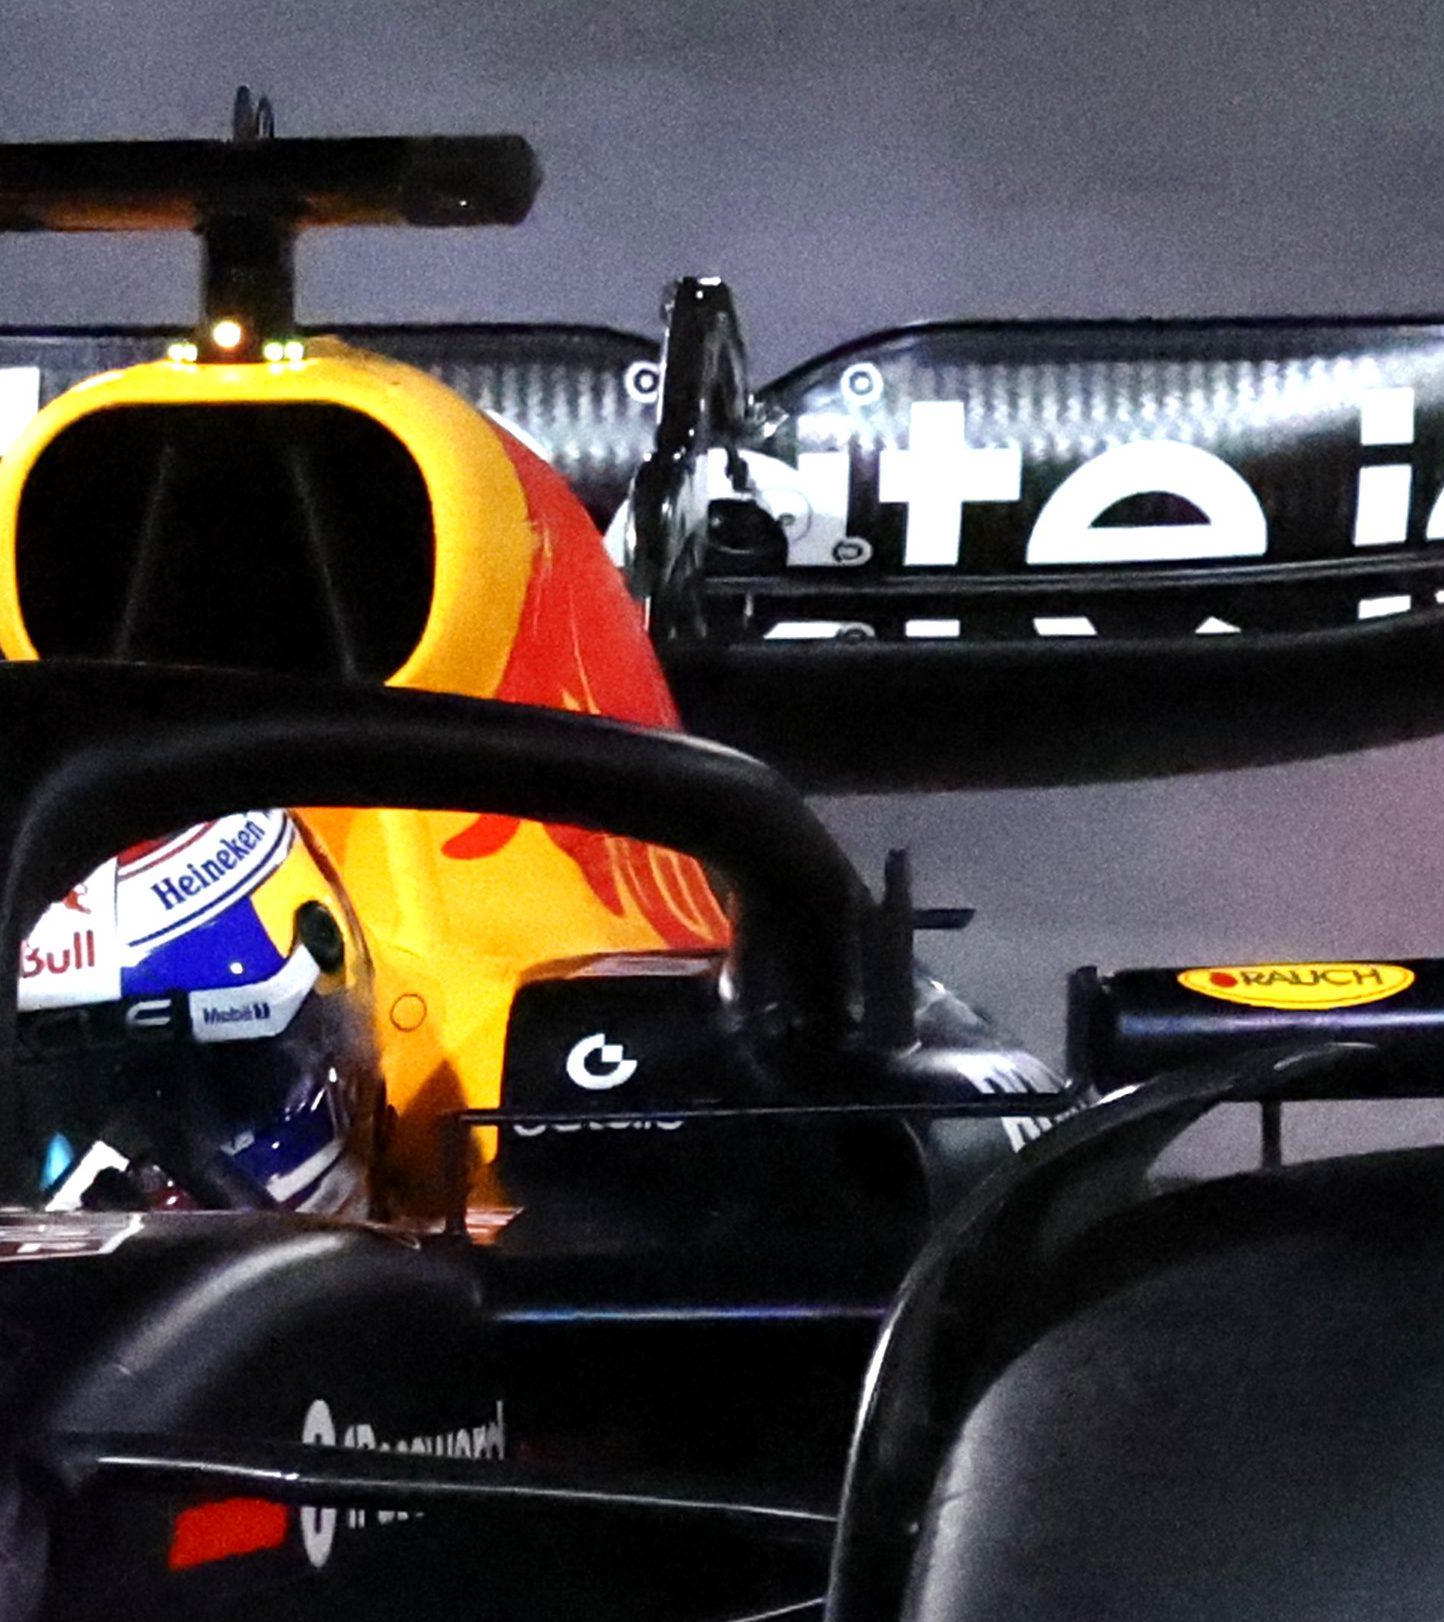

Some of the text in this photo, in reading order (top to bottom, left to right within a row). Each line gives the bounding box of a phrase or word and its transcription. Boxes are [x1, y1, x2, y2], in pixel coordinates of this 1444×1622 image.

[150, 818, 266, 911] Heineken
[19, 929, 95, 979] Bull
[1240, 967, 1384, 987] RAUCH
